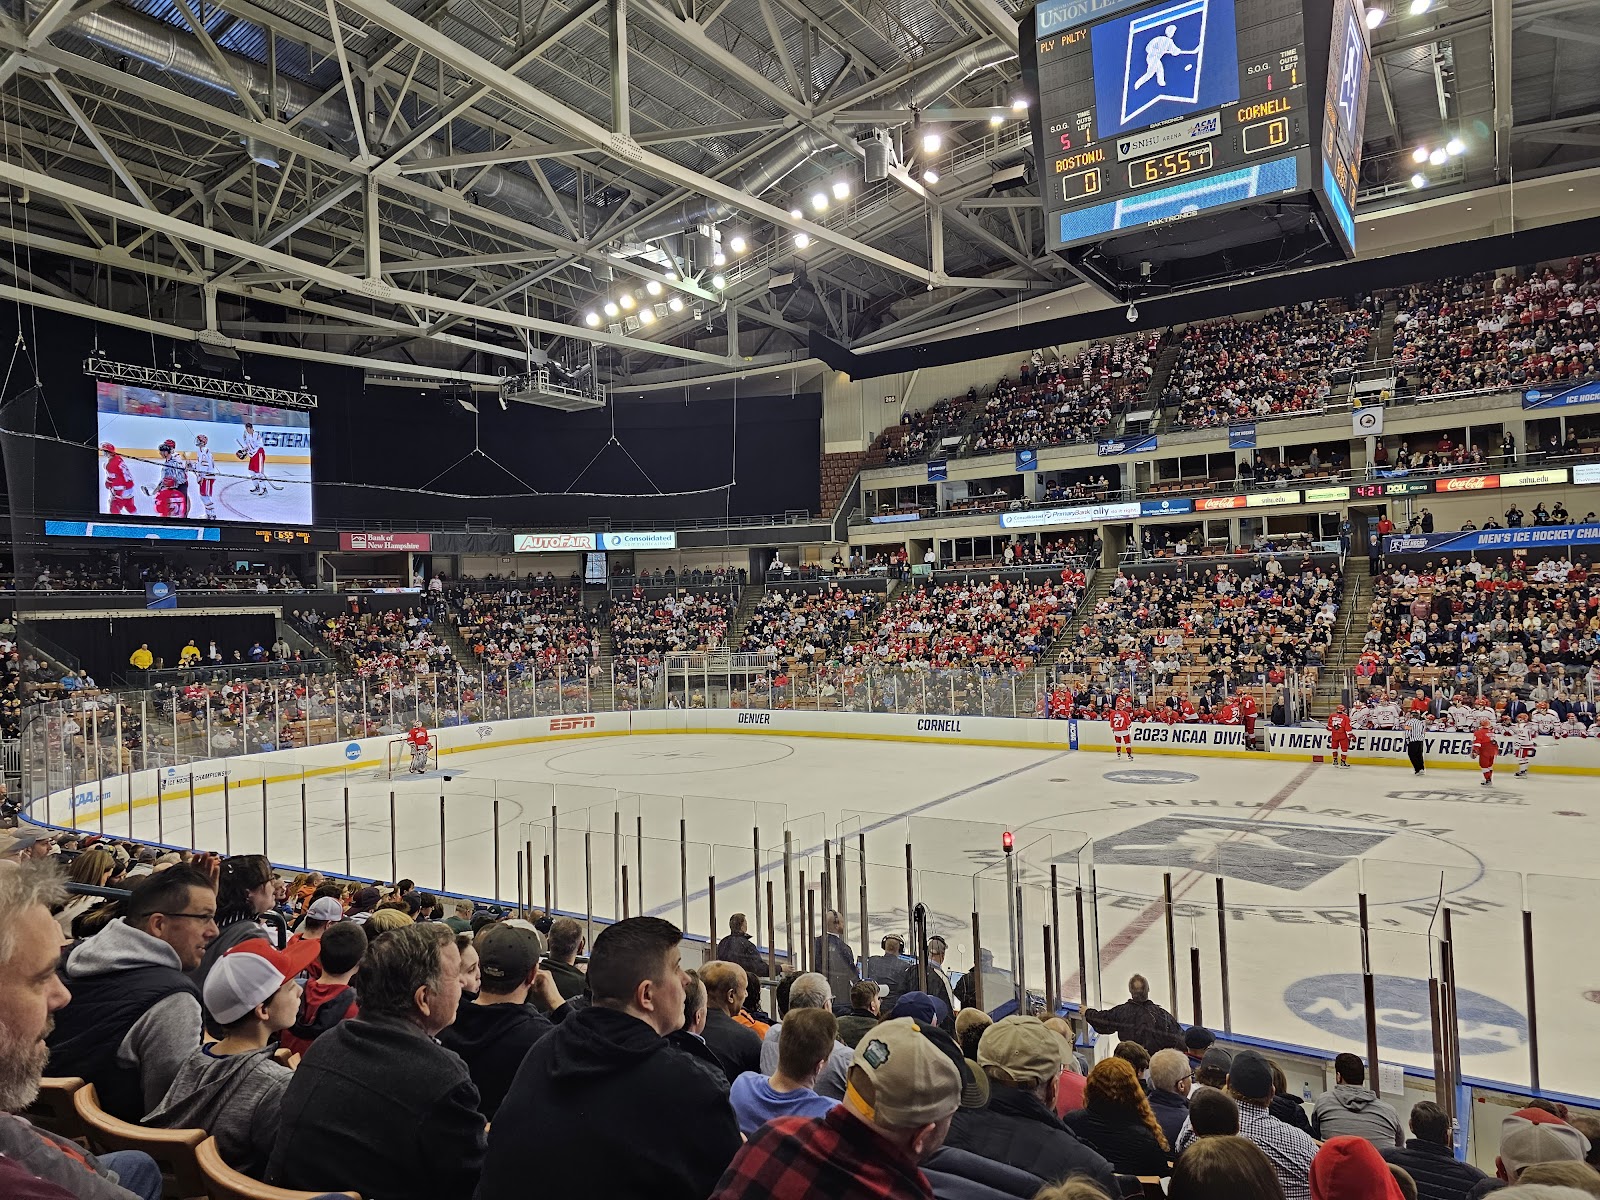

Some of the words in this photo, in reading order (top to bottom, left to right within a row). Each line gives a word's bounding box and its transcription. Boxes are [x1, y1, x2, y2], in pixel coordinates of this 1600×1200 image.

[1040, 2, 1088, 28] UNION
[1041, 40, 1055, 53] PLY
[1061, 29, 1087, 46] PNLTY
[1280, 48, 1297, 58] TIME
[1280, 55, 1298, 65] OUTS
[1247, 62, 1271, 74] S.O.G.
[1280, 62, 1298, 72] LEFT
[1291, 68, 1296, 83] 1
[1267, 75, 1272, 90] 1
[1076, 110, 1091, 119] TIME
[1238, 97, 1291, 122] CORNELL
[1076, 116, 1092, 125] OUTS
[1050, 122, 1069, 133] S.O.G.
[1077, 122, 1092, 131] LEFT
[1086, 128, 1090, 142] 1
[1269, 121, 1283, 145] 0
[1060, 133, 1071, 150] 5
[1132, 136, 1160, 150] SNHU
[1162, 132, 1182, 142] ARENA
[1188, 147, 1210, 157] PERIOD
[1199, 154, 1204, 165] 1
[1145, 151, 1191, 181] 6:55
[1084, 172, 1097, 193] 0
[1147, 210, 1198, 227] DAKTRONICS
[1566, 395, 1579, 403] ICE
[1447, 476, 1485, 490] Coca-Cola
[1518, 475, 1549, 484] snhu.edu
[1357, 486, 1381, 496] 4:21
[1386, 483, 1407, 492] DCU
[1204, 498, 1235, 509] Coca-Cola
[1093, 507, 1110, 516] ally
[278, 531, 294, 539] 6:55
[367, 533, 385, 541] Bank
[624, 534, 672, 542] Consolidated
[1478, 533, 1511, 544] MEN'S
[1513, 531, 1530, 542] ICE
[1532, 529, 1575, 541] HOCKEY
[384, 541, 420, 550] Hampshire
[549, 716, 596, 731] ESPN
[738, 712, 770, 725] DENVER
[1113, 717, 1125, 728] 27
[917, 718, 962, 732] CORNELL
[1133, 728, 1169, 742] 2023
[1172, 729, 1207, 744] NCAA
[1280, 733, 1285, 747] I
